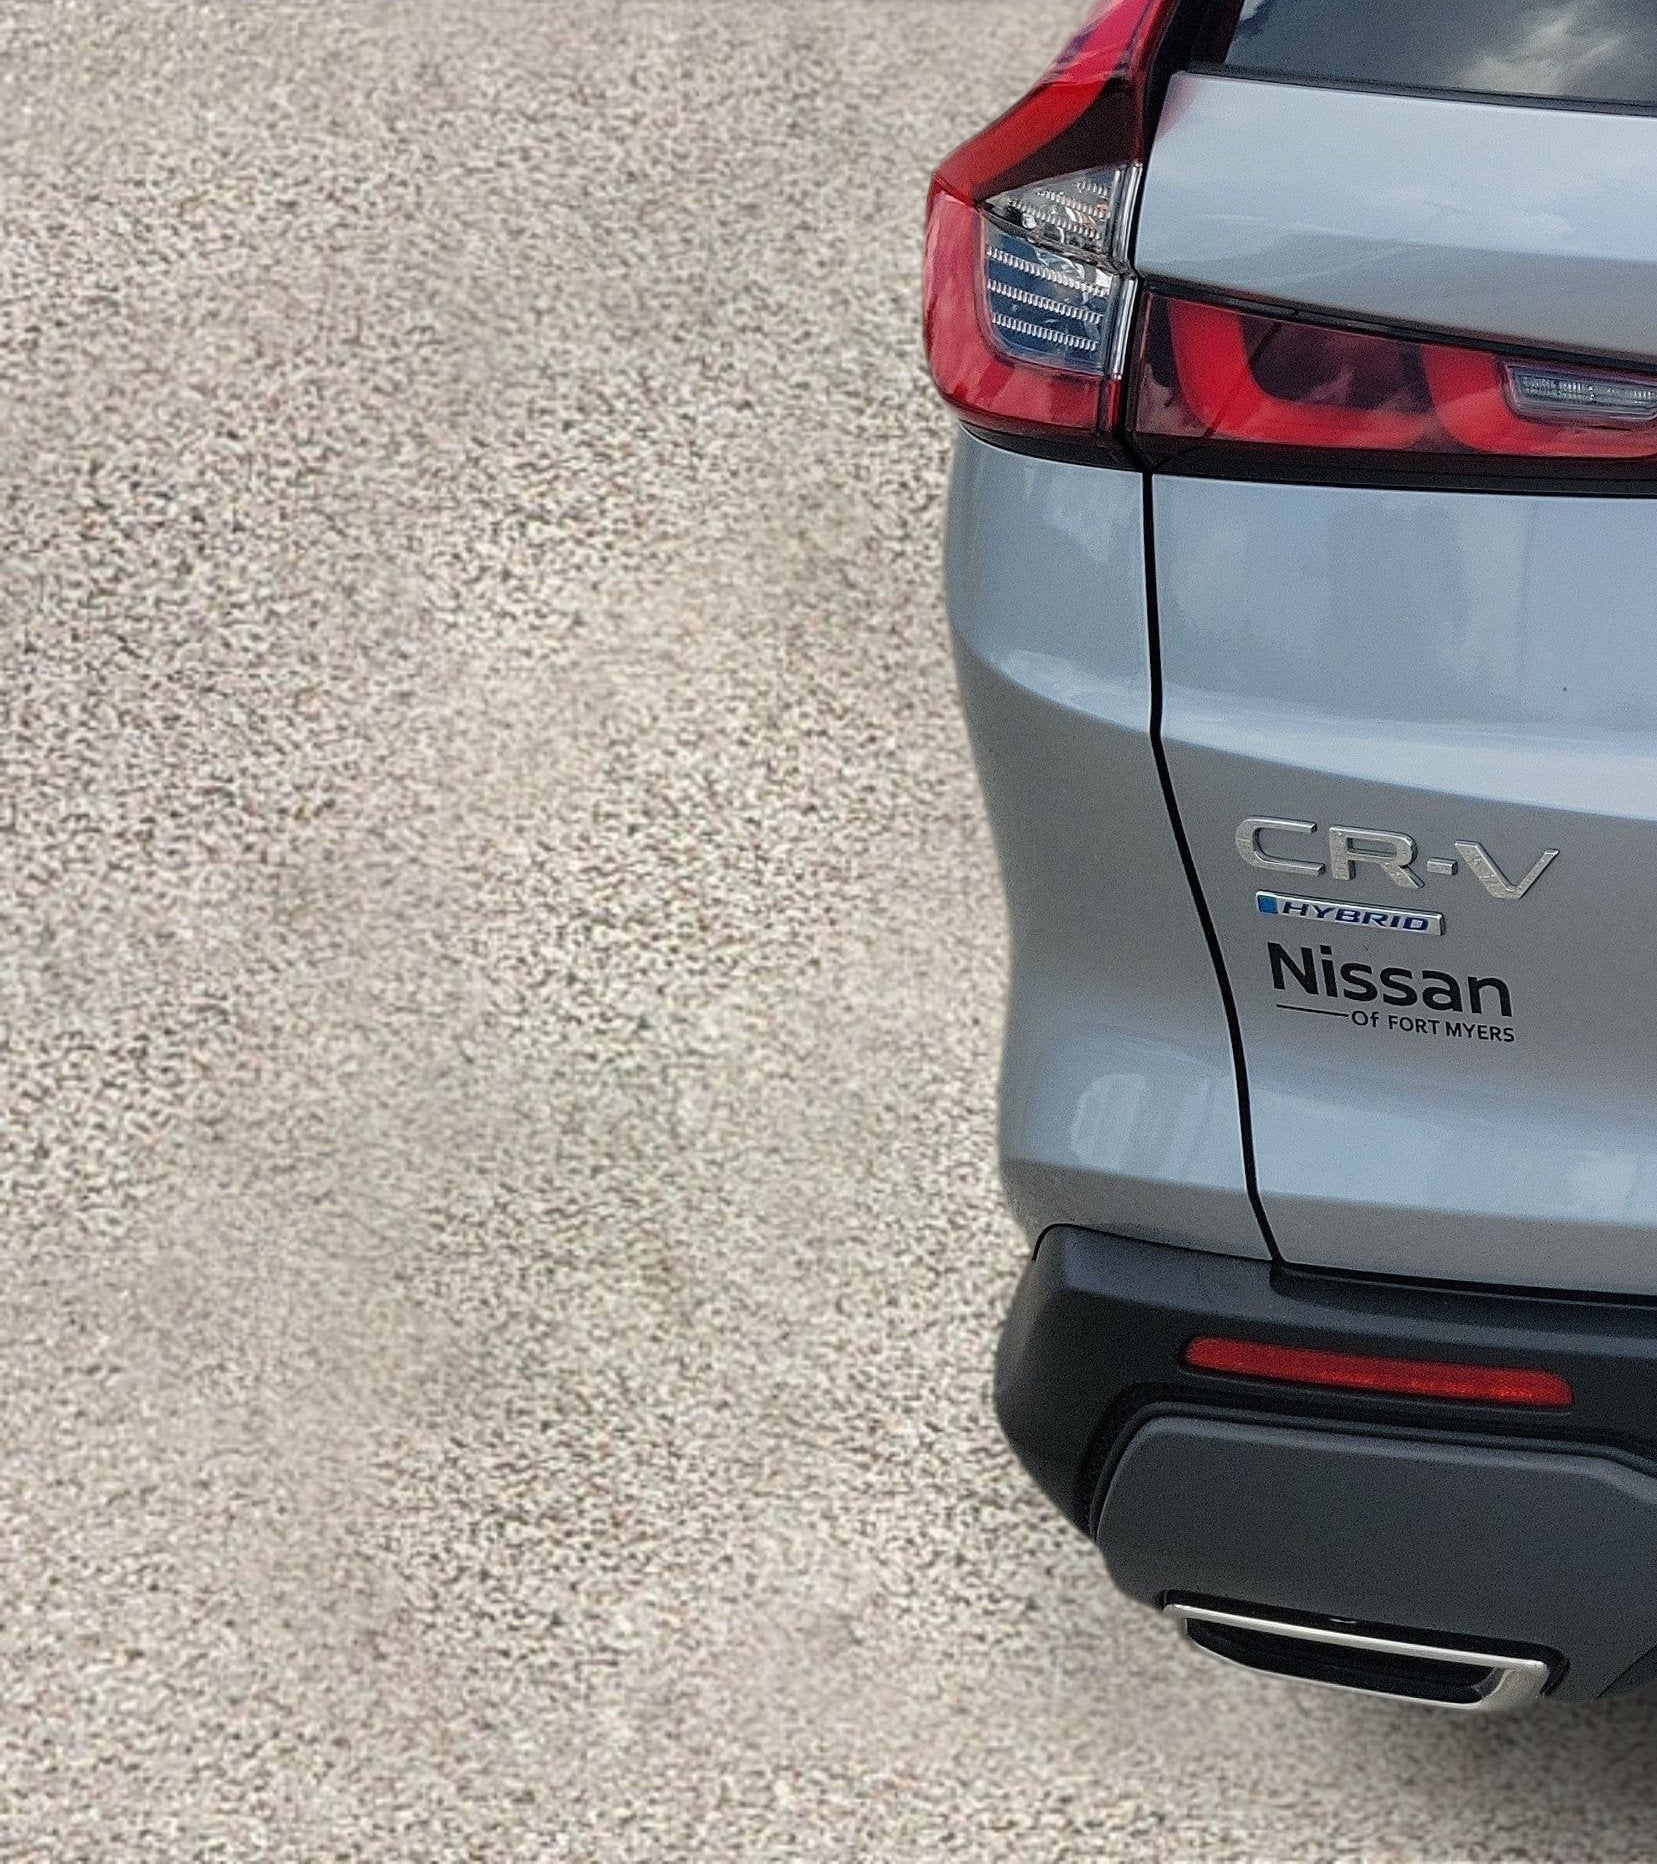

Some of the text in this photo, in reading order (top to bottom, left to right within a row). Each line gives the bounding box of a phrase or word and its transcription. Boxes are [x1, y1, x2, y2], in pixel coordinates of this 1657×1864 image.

[1235, 815, 1560, 900] CR-V
[1282, 900, 1430, 933] HYBRID
[1267, 941, 1514, 1018] Nissan
[1388, 1015, 1440, 1037] FORT
[1445, 1020, 1516, 1043] MYERS
